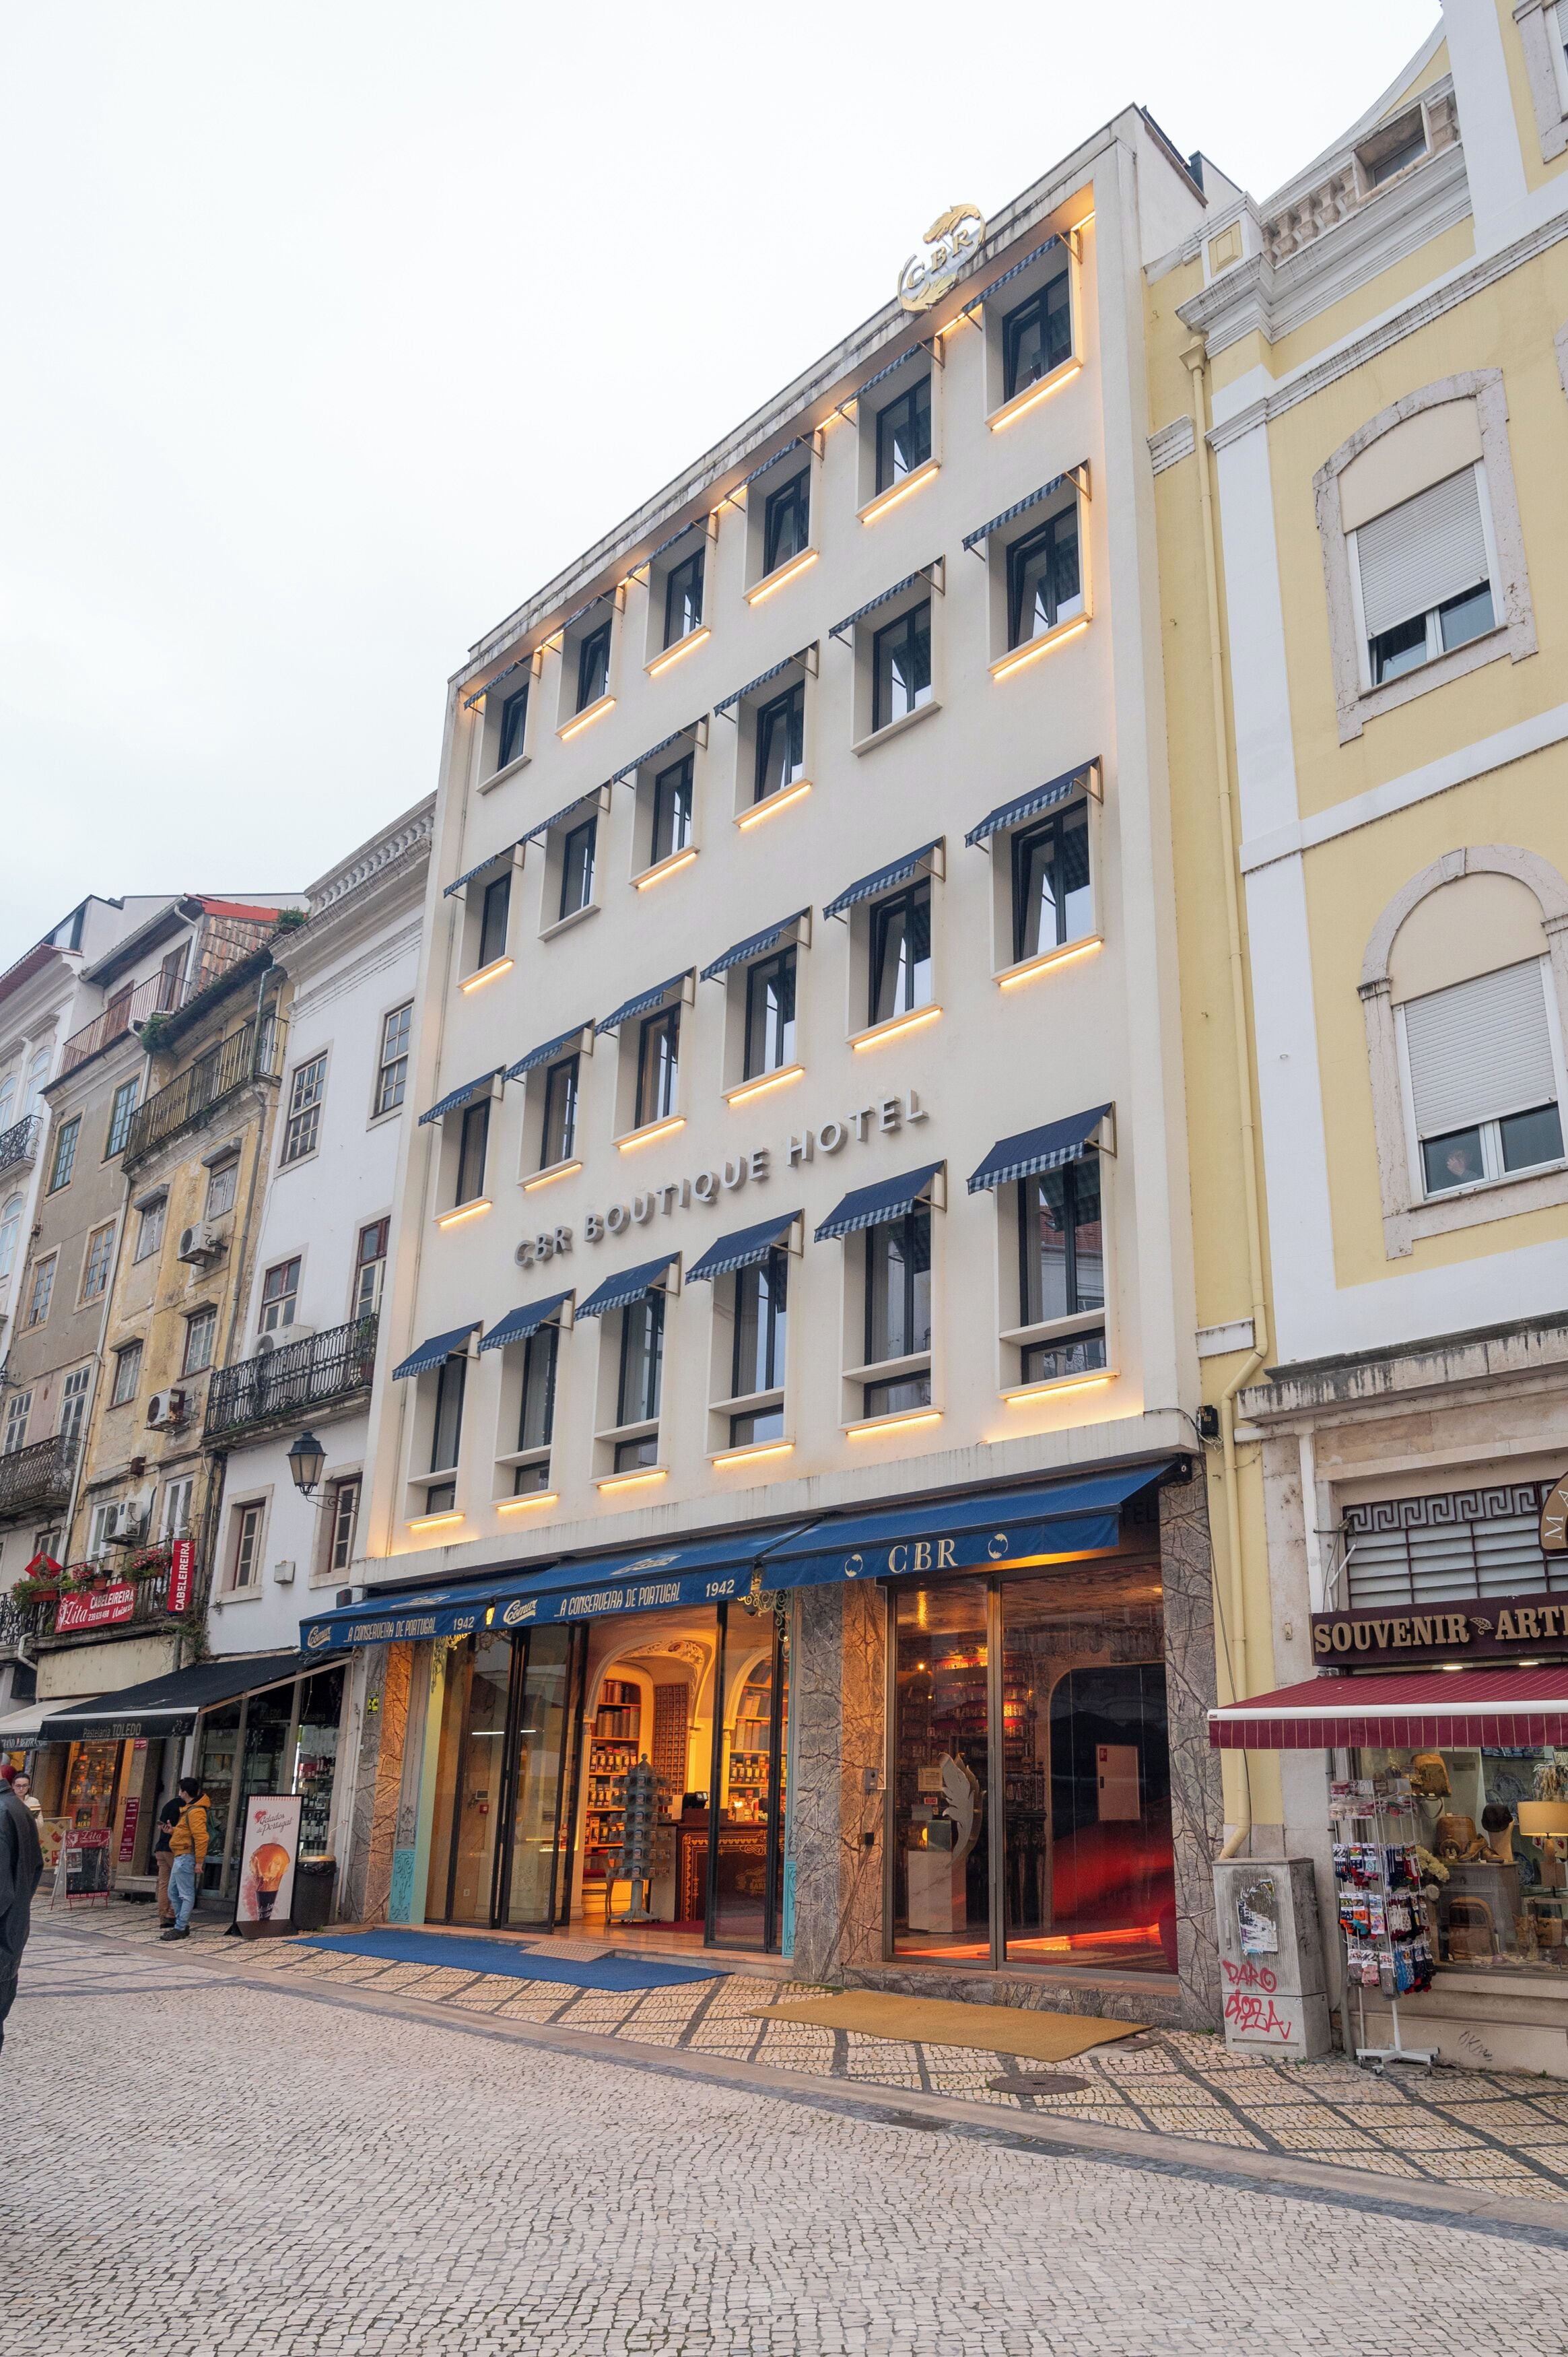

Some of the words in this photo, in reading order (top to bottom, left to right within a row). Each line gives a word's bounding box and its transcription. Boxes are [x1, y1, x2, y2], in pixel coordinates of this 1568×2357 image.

[907, 229, 974, 290] CBR
[514, 1224, 573, 1268] CBR
[583, 1147, 769, 1244] BOUTIQUE
[786, 1089, 929, 1168] HOTEL
[888, 1539, 958, 1574] CBR
[175, 1542, 191, 1610] CABELEIREIRA
[90, 1589, 134, 1609] CABELEIREIRA
[569, 1589, 623, 1616] CONSERVEIRA
[625, 1587, 638, 1608] DE
[638, 1581, 681, 1607] PORTUGAL
[705, 1579, 735, 1597] 1942
[353, 1621, 394, 1642] CONSERVEIRA
[395, 1621, 403, 1637] DE
[405, 1617, 437, 1636] PORTUGAL
[453, 1616, 475, 1631] 1942
[1314, 1614, 1470, 1653] SOUVENIR
[83, 1727, 111, 1737] Pastelaria
[112, 1723, 141, 1737] TOLEDO
[262, 1817, 292, 1836] Portugal
